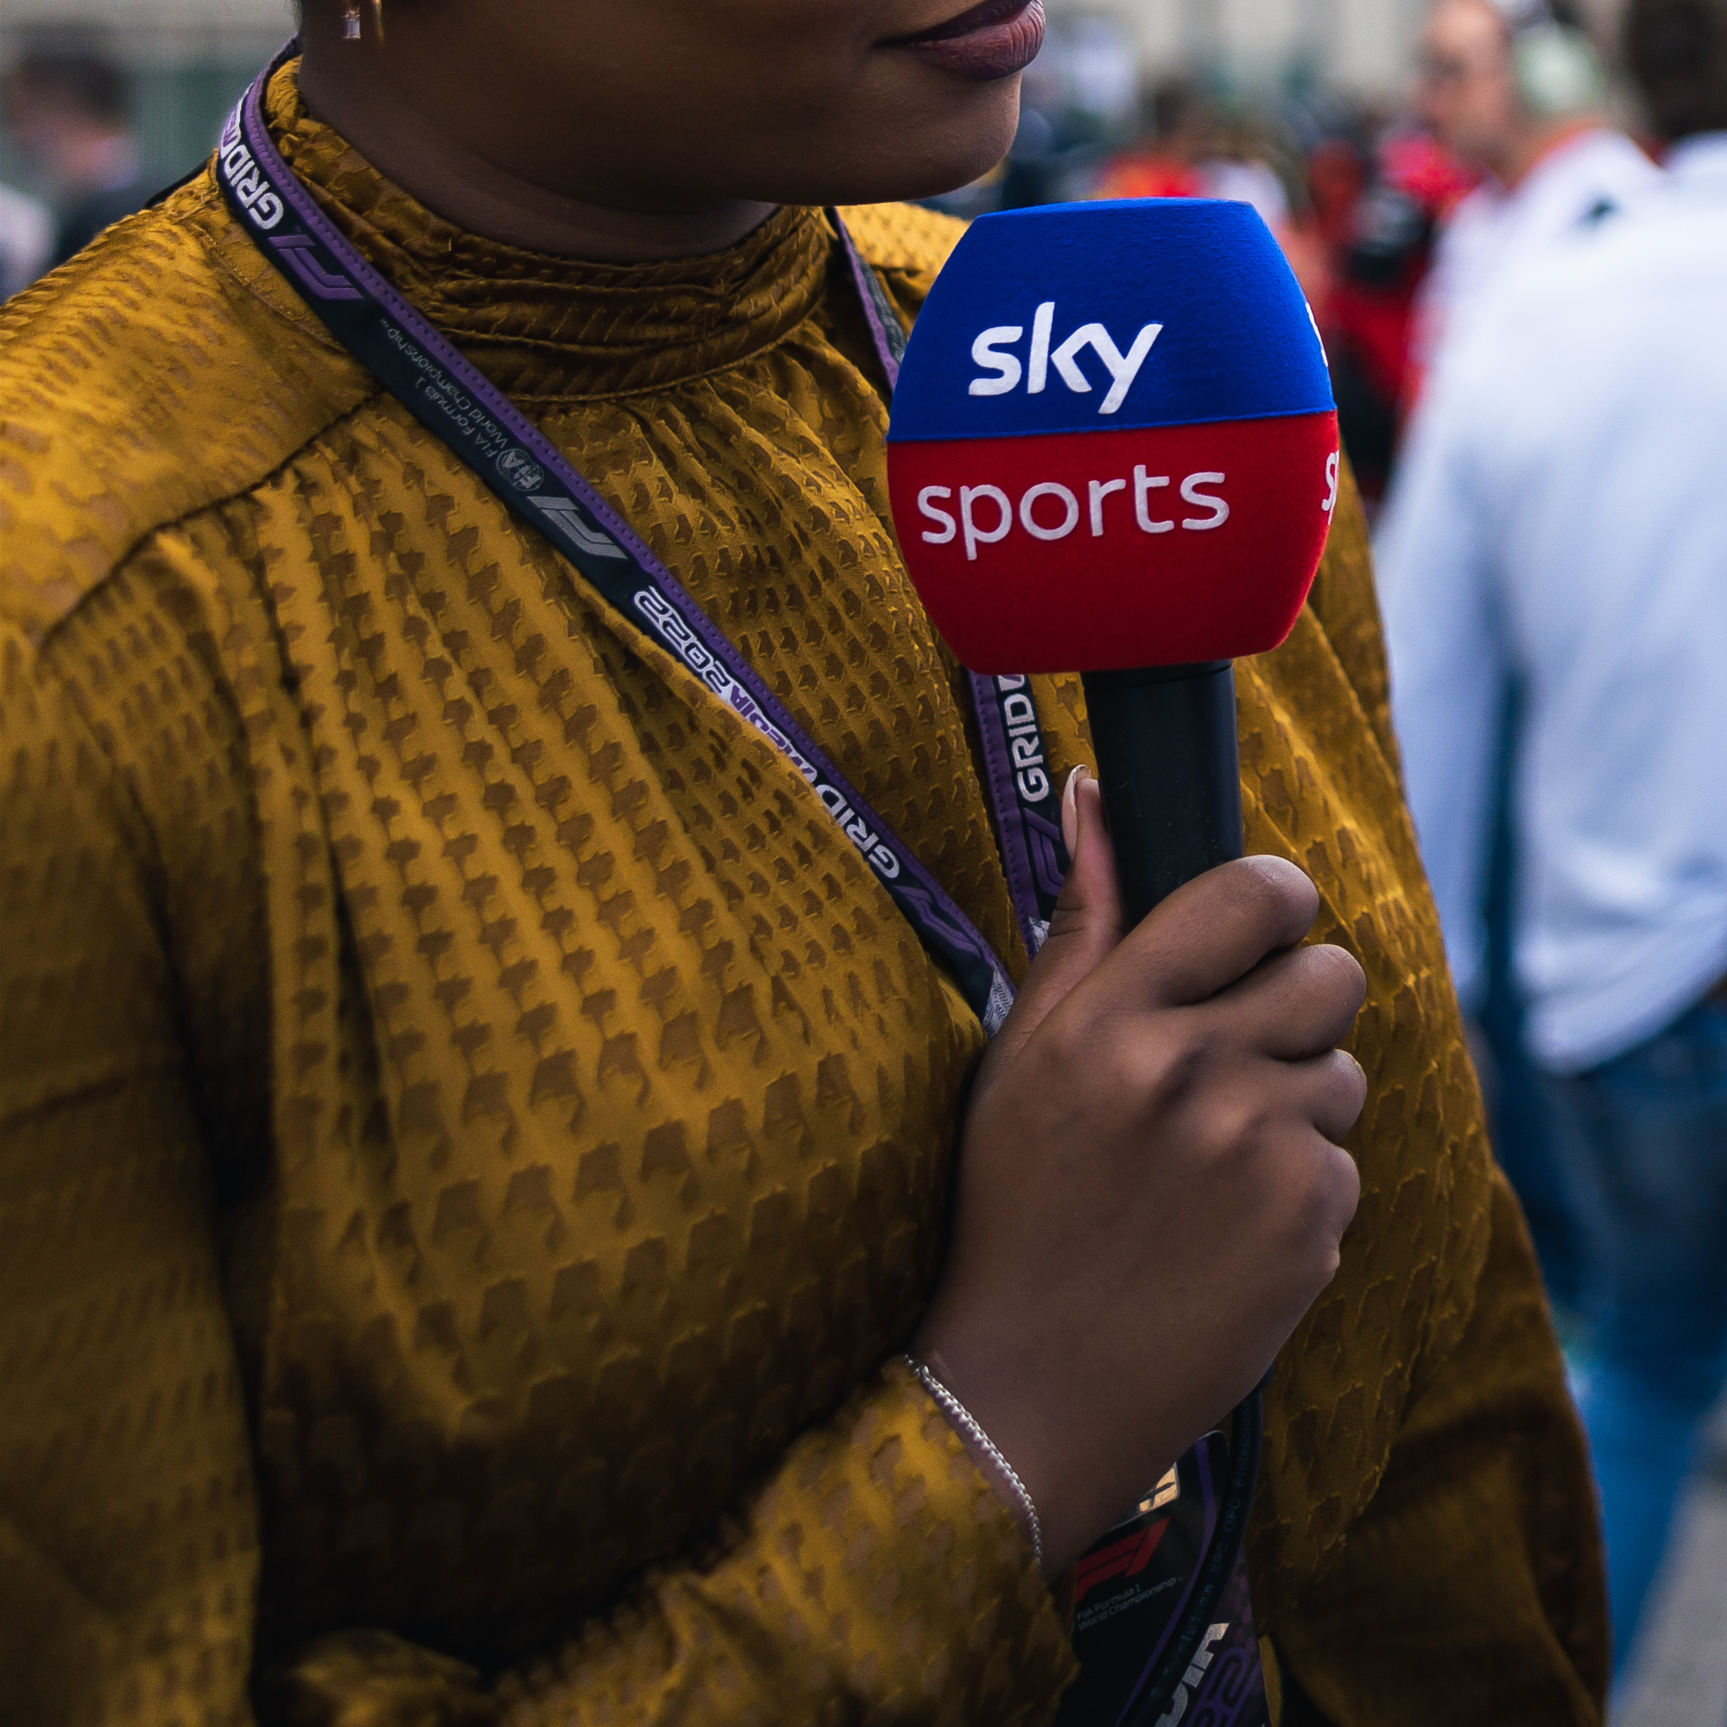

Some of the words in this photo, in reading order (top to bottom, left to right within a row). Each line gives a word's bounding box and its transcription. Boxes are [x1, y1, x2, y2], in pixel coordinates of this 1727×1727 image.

[223, 143, 285, 230] GRID
[967, 301, 1164, 415] sky
[425, 385, 476, 436] Formula
[468, 407, 509, 449] World
[916, 464, 1231, 561] sports
[633, 584, 733, 695] 2022
[1003, 693, 1050, 803] GRID
[816, 784, 900, 879] GRID
